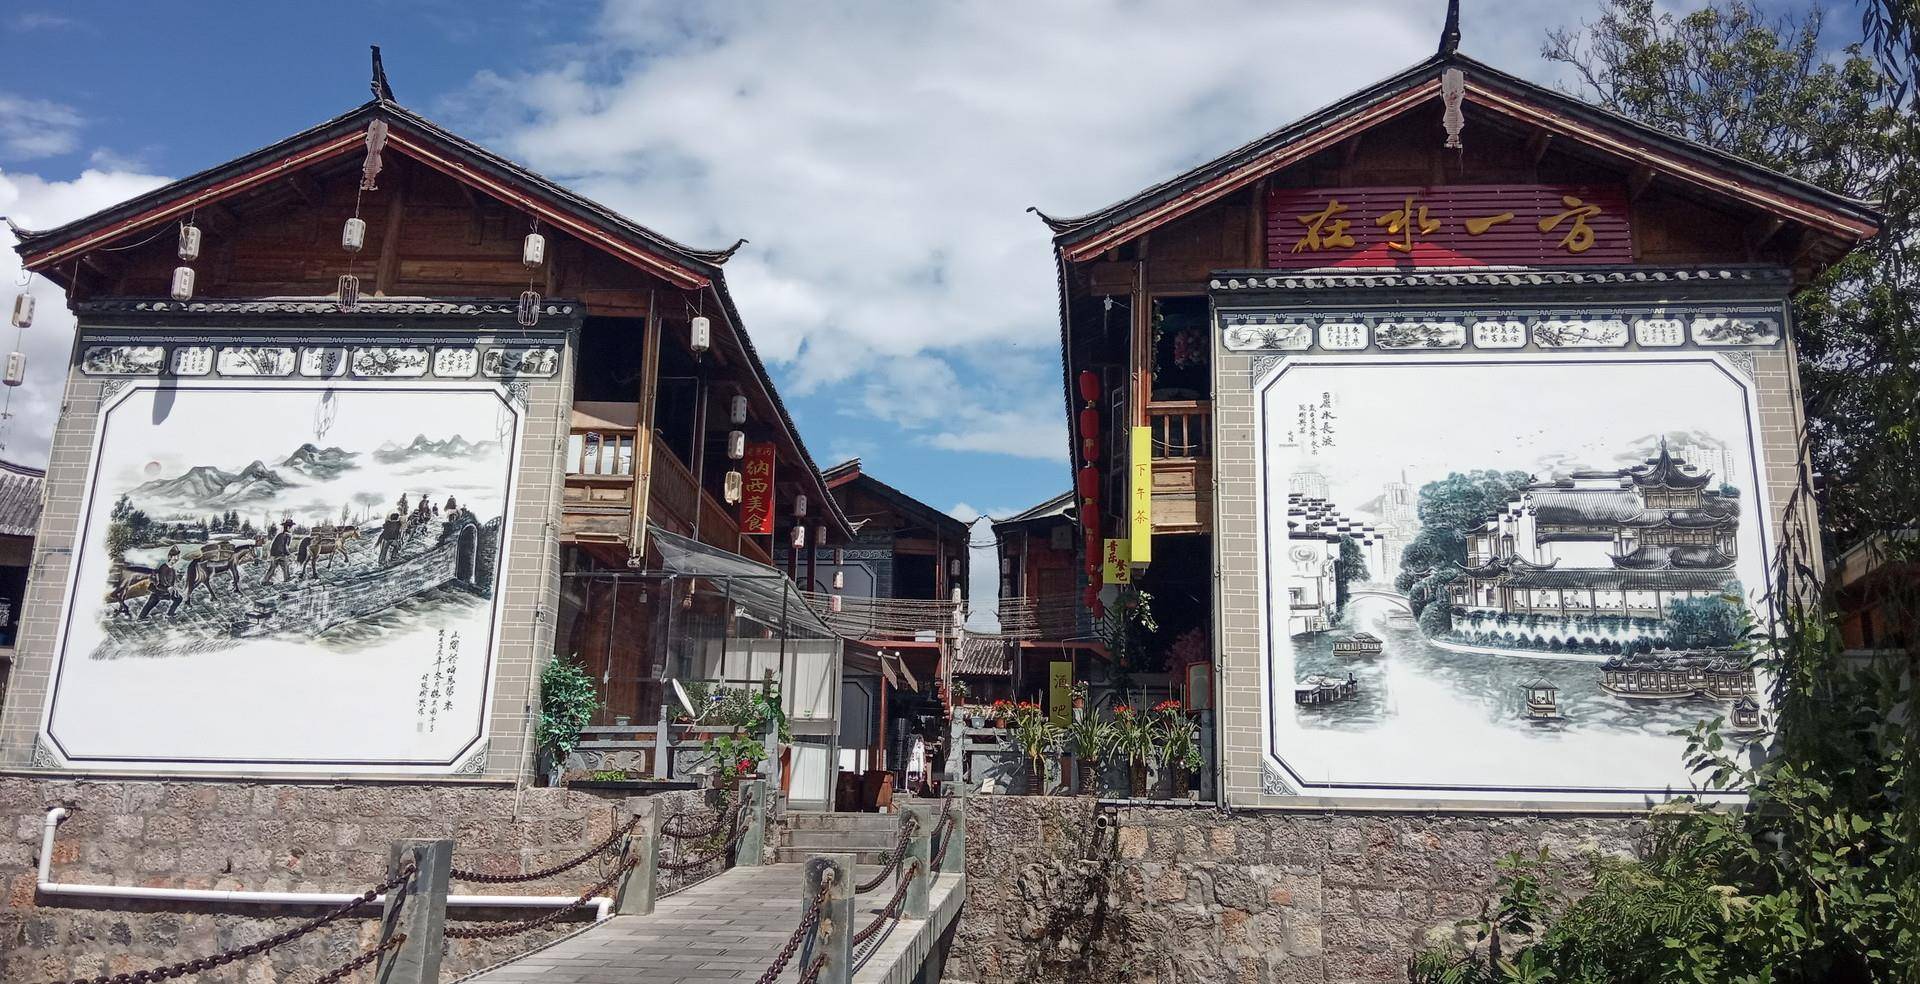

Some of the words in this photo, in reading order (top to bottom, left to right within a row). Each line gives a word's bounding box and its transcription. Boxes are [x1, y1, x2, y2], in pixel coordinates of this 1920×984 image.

[1291, 194, 1603, 254] 在水一方
[744, 460, 770, 532] 纳西美食
[1134, 463, 1148, 525] 下午茶
[1052, 673, 1069, 717] 酒吧
